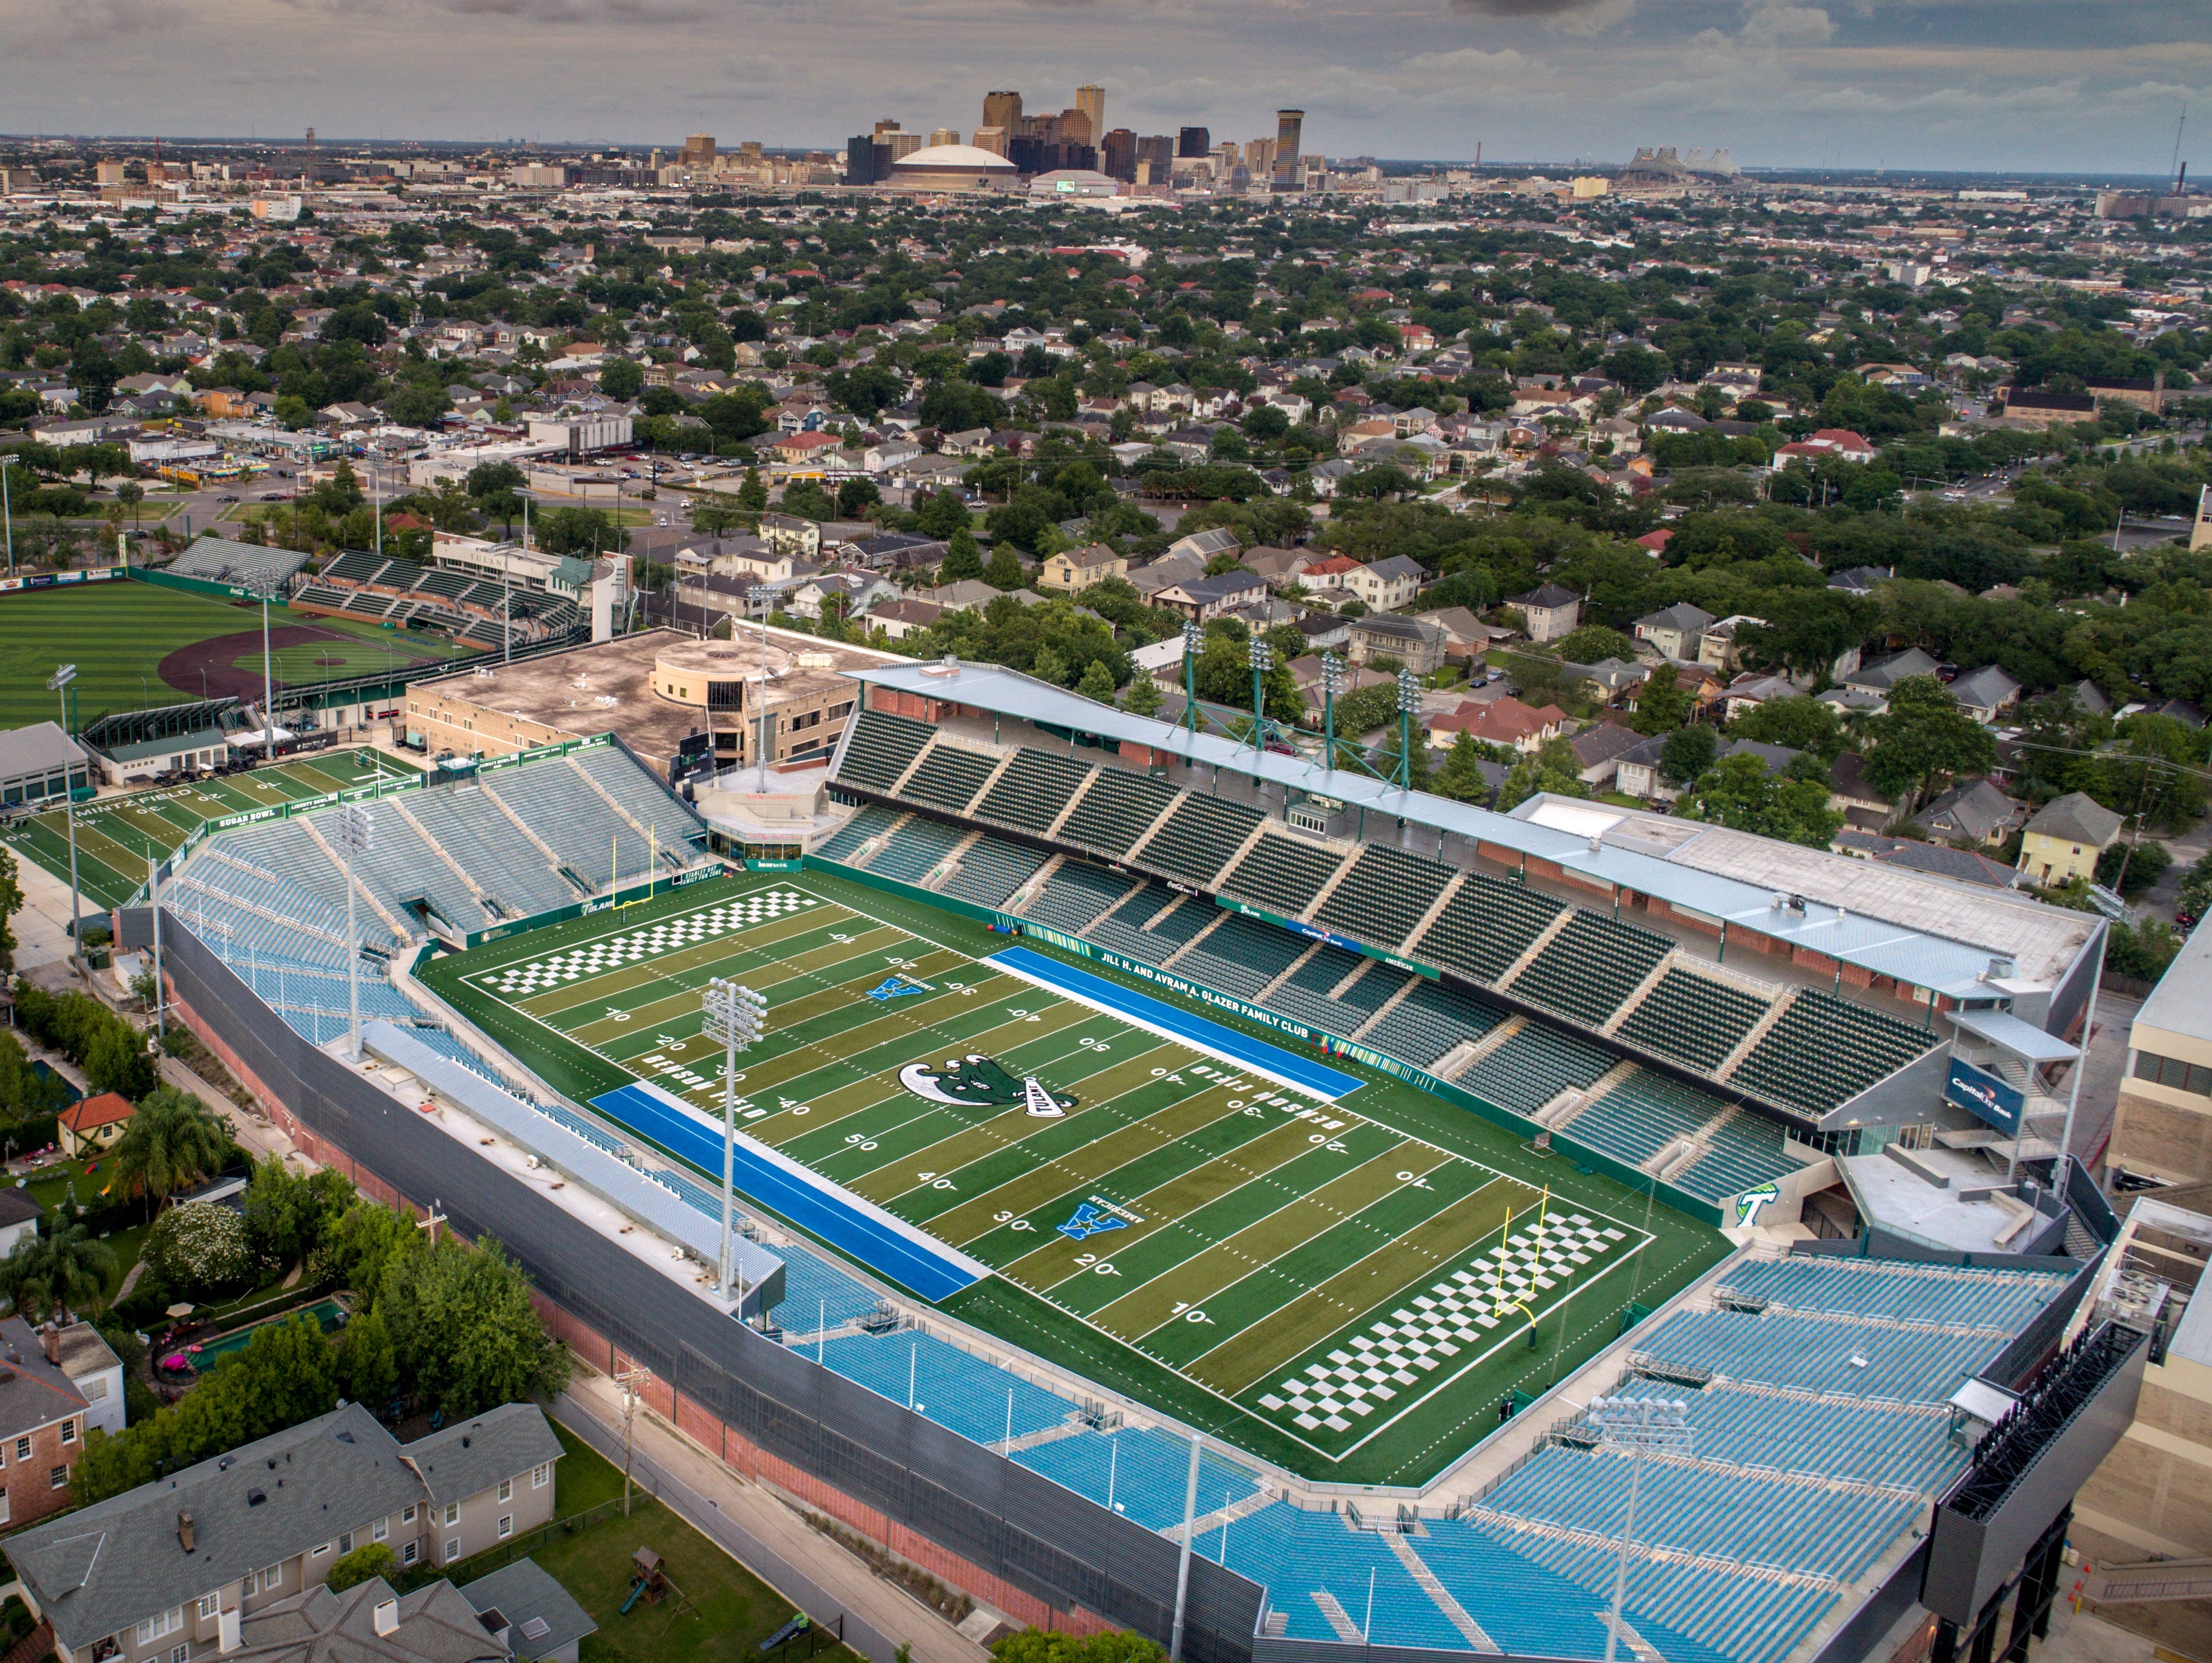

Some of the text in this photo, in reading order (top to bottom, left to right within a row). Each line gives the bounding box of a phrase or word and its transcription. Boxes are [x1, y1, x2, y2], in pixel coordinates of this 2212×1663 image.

[470, 553, 507, 567] TULAN
[75, 789, 192, 817] MINTZ FIELD
[291, 801, 312, 809] LIBERTY
[219, 814, 248, 827] SUGAR
[250, 809, 274, 821] BOWL
[6, 833, 32, 841] 50
[685, 869, 706, 879] STANLEY
[709, 869, 722, 878] ZONE
[833, 934, 855, 944] 10
[1330, 938, 1343, 947] Bank
[889, 958, 917, 969] 20
[1385, 957, 1414, 971] AMERICAN
[894, 973, 937, 991] AMERICAN
[949, 983, 977, 995] 30
[1101, 952, 1309, 1038] JILL H. AND AVRAM A. GLAZER FAMILY CLUB
[606, 1008, 631, 1021] 10
[1012, 1010, 1041, 1021] 40
[656, 1036, 686, 1050] 20
[1079, 1037, 1110, 1052] 50
[642, 1054, 716, 1091] BENSON
[1150, 1068, 1182, 1084] 40
[1028, 1085, 1053, 1112] TULANE
[1190, 1066, 1345, 1130] BENSON FIELD
[779, 1100, 810, 1115] 40
[1227, 1100, 1261, 1116] 30
[1993, 1105, 2012, 1119] Bank
[845, 1134, 878, 1150] 50
[1309, 1134, 1347, 1151] 20
[917, 1172, 951, 1189] 40
[1396, 1171, 1427, 1188] 10
[1088, 1195, 1145, 1224] AMERICAN
[993, 1211, 1030, 1230] 30
[1073, 1254, 1114, 1275] 20
[1171, 1302, 1206, 1323] 10
